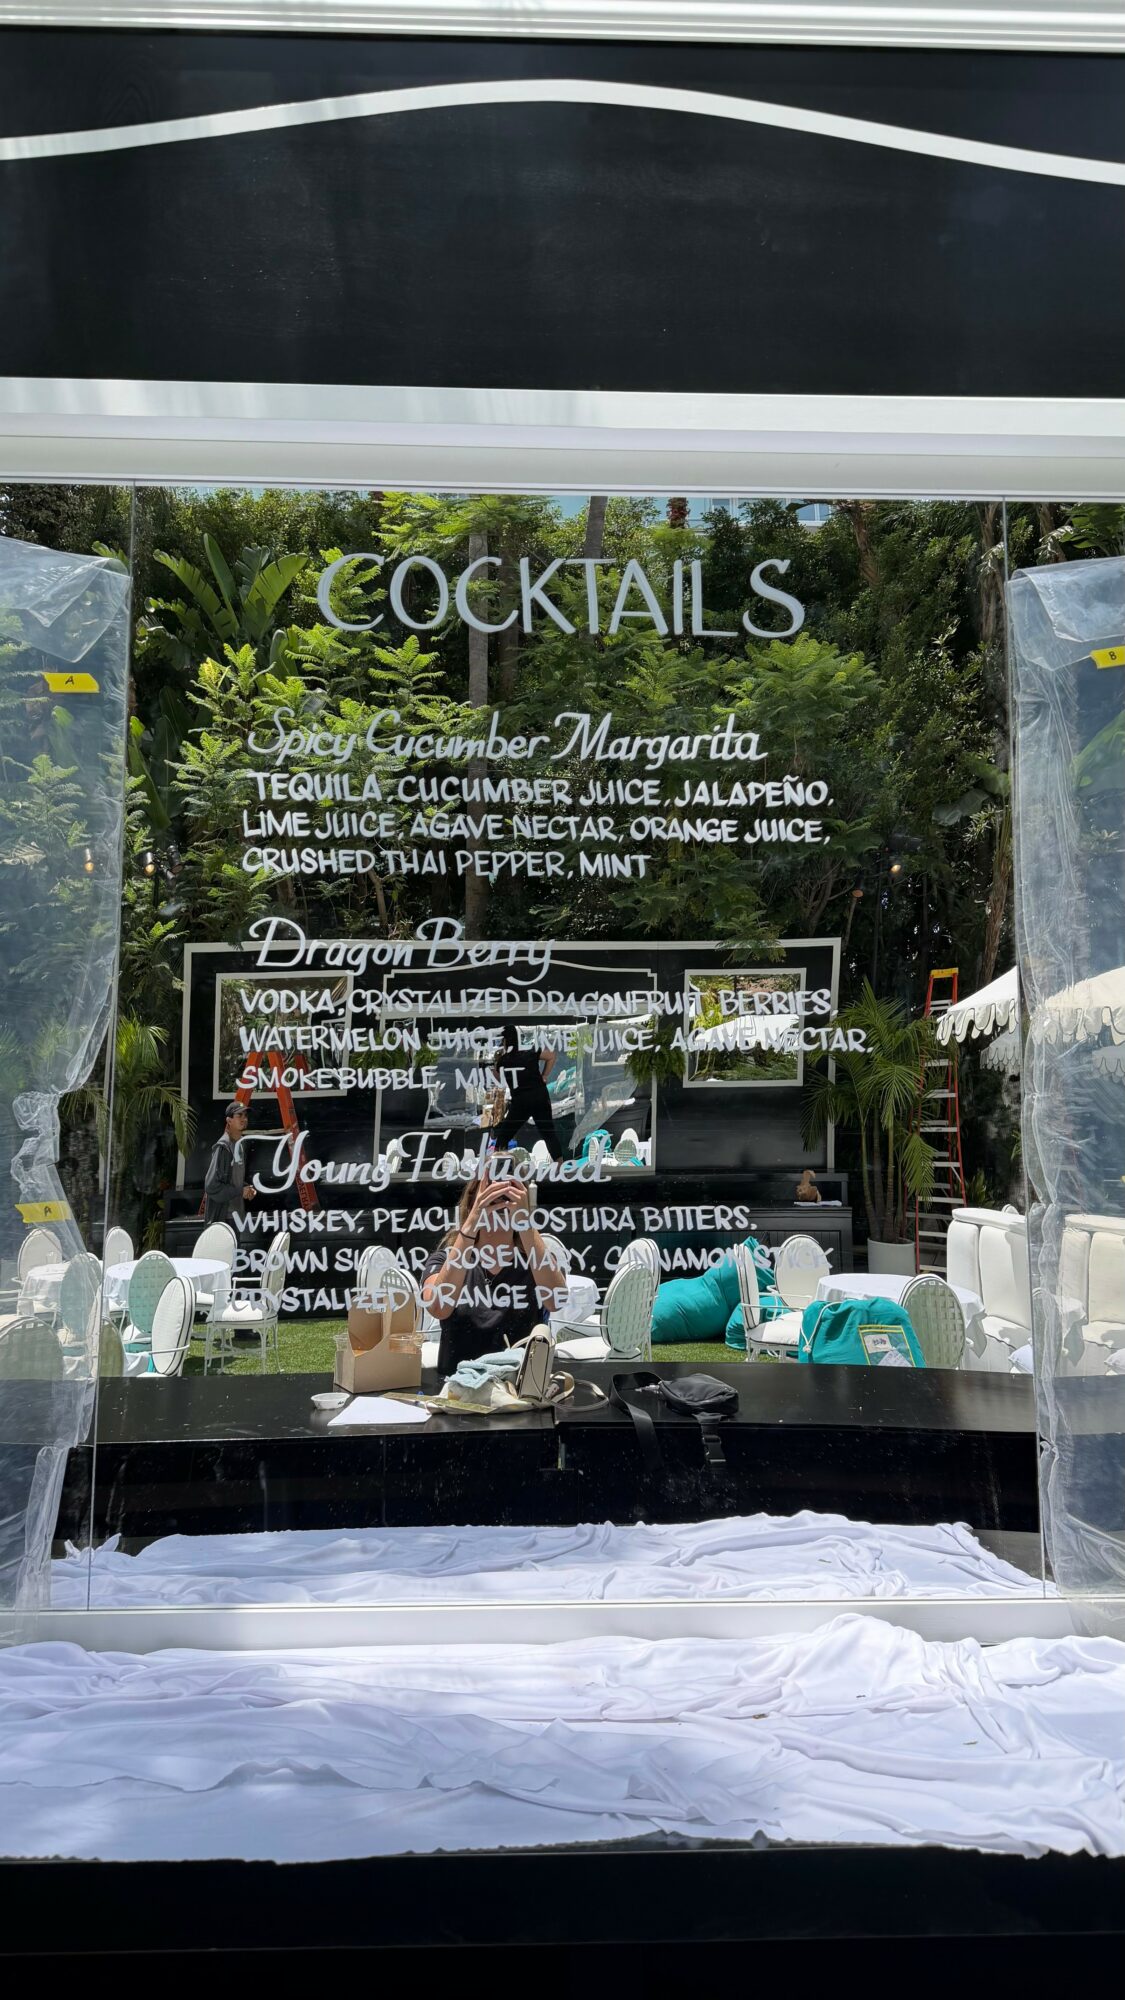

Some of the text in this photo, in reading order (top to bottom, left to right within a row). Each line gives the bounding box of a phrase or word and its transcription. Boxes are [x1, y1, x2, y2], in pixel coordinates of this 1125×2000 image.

[316, 552, 806, 638] COCKTAILS
[64, 675, 75, 686] A
[247, 707, 769, 770] Spicy Cucumber Margarita
[247, 771, 835, 807] TEQUILA, CUCUMBER JUICE, JALAPEÑO,
[242, 809, 831, 846] LIME JUICE, AGAVE NECTAR, ORANGE JUICE,
[241, 847, 653, 880] CRUSHED THAI PEPPER, MINT
[248, 916, 556, 986] Dragon Berry
[239, 988, 345, 1016] VODKA,
[348, 987, 521, 1016] CRYSTALIZED
[718, 988, 839, 1016] BERRIES,
[238, 1025, 875, 1054] WATERMELON JUICE, LIME JUICE, AGAVE NECTAR,
[454, 1066, 526, 1091] MINT
[233, 1128, 614, 1195] Young Fashioned
[231, 1208, 366, 1234] WHISKEY,
[473, 1205, 636, 1233] ANGOSTURA
[231, 1247, 329, 1274] BROWN
[230, 1285, 410, 1313] CRYSTALIZED
[416, 1282, 530, 1310] ORANGE
